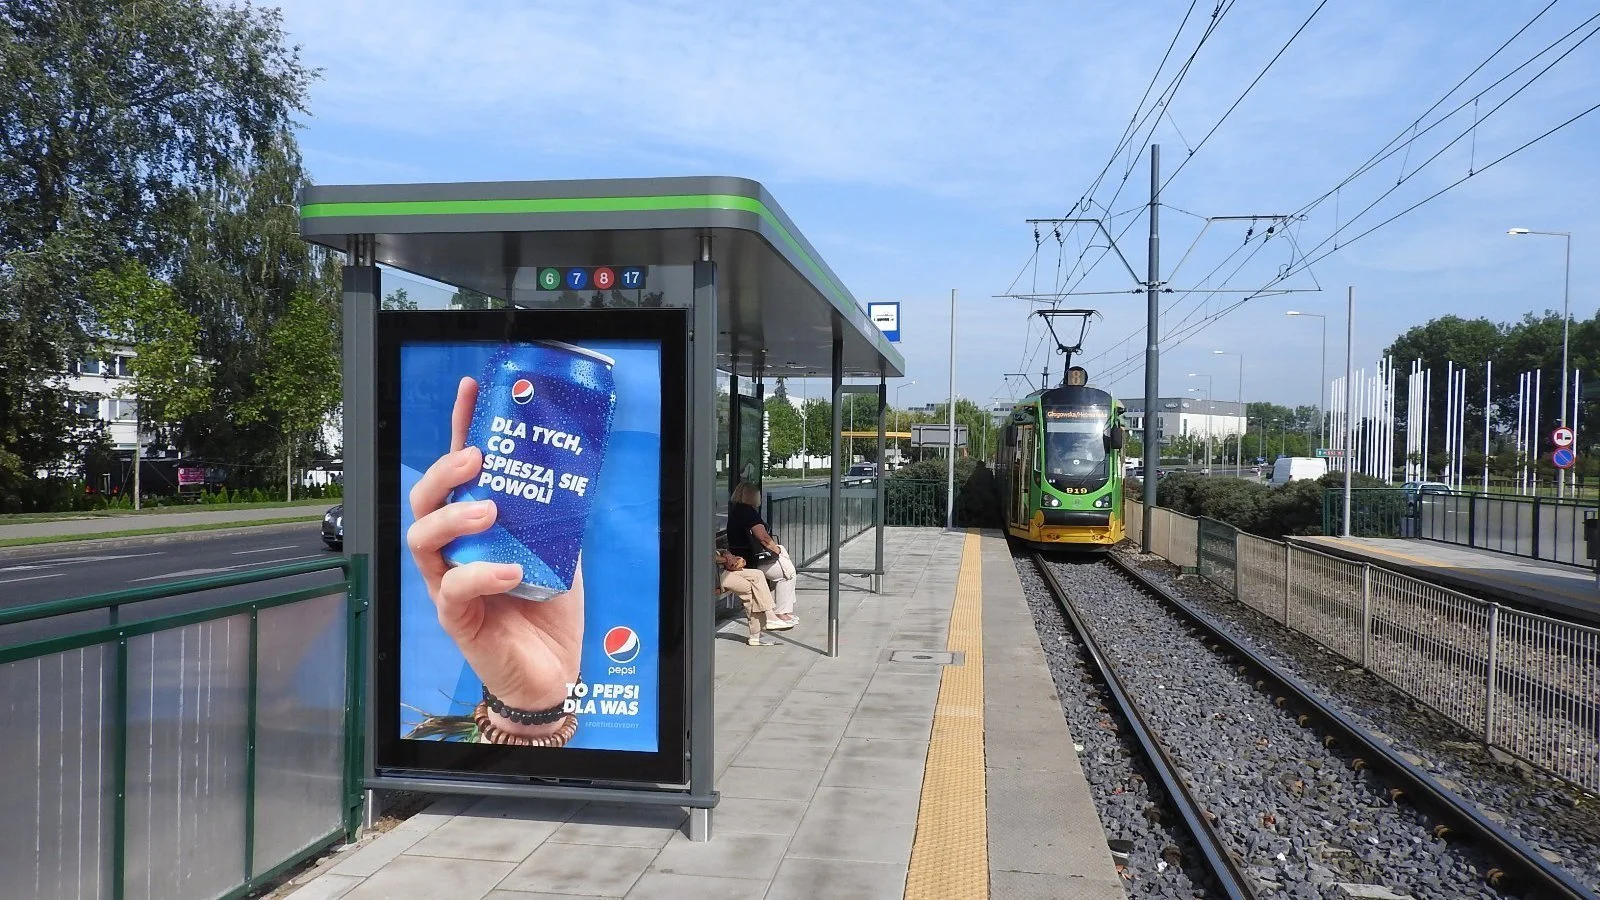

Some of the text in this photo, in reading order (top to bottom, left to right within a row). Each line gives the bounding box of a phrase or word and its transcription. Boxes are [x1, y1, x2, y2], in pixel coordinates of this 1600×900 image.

[545, 271, 640, 285] 6 7 8 17
[1071, 370, 1081, 385] 8
[491, 416, 583, 455] DLA TYCH,
[487, 435, 515, 455] CO
[482, 454, 589, 497] SPIESZĄ SIĘ
[478, 472, 553, 504] POWOLI
[608, 665, 636, 676] pepsi
[565, 683, 640, 699] TO PEPSI
[563, 699, 639, 716] DLA WAS
